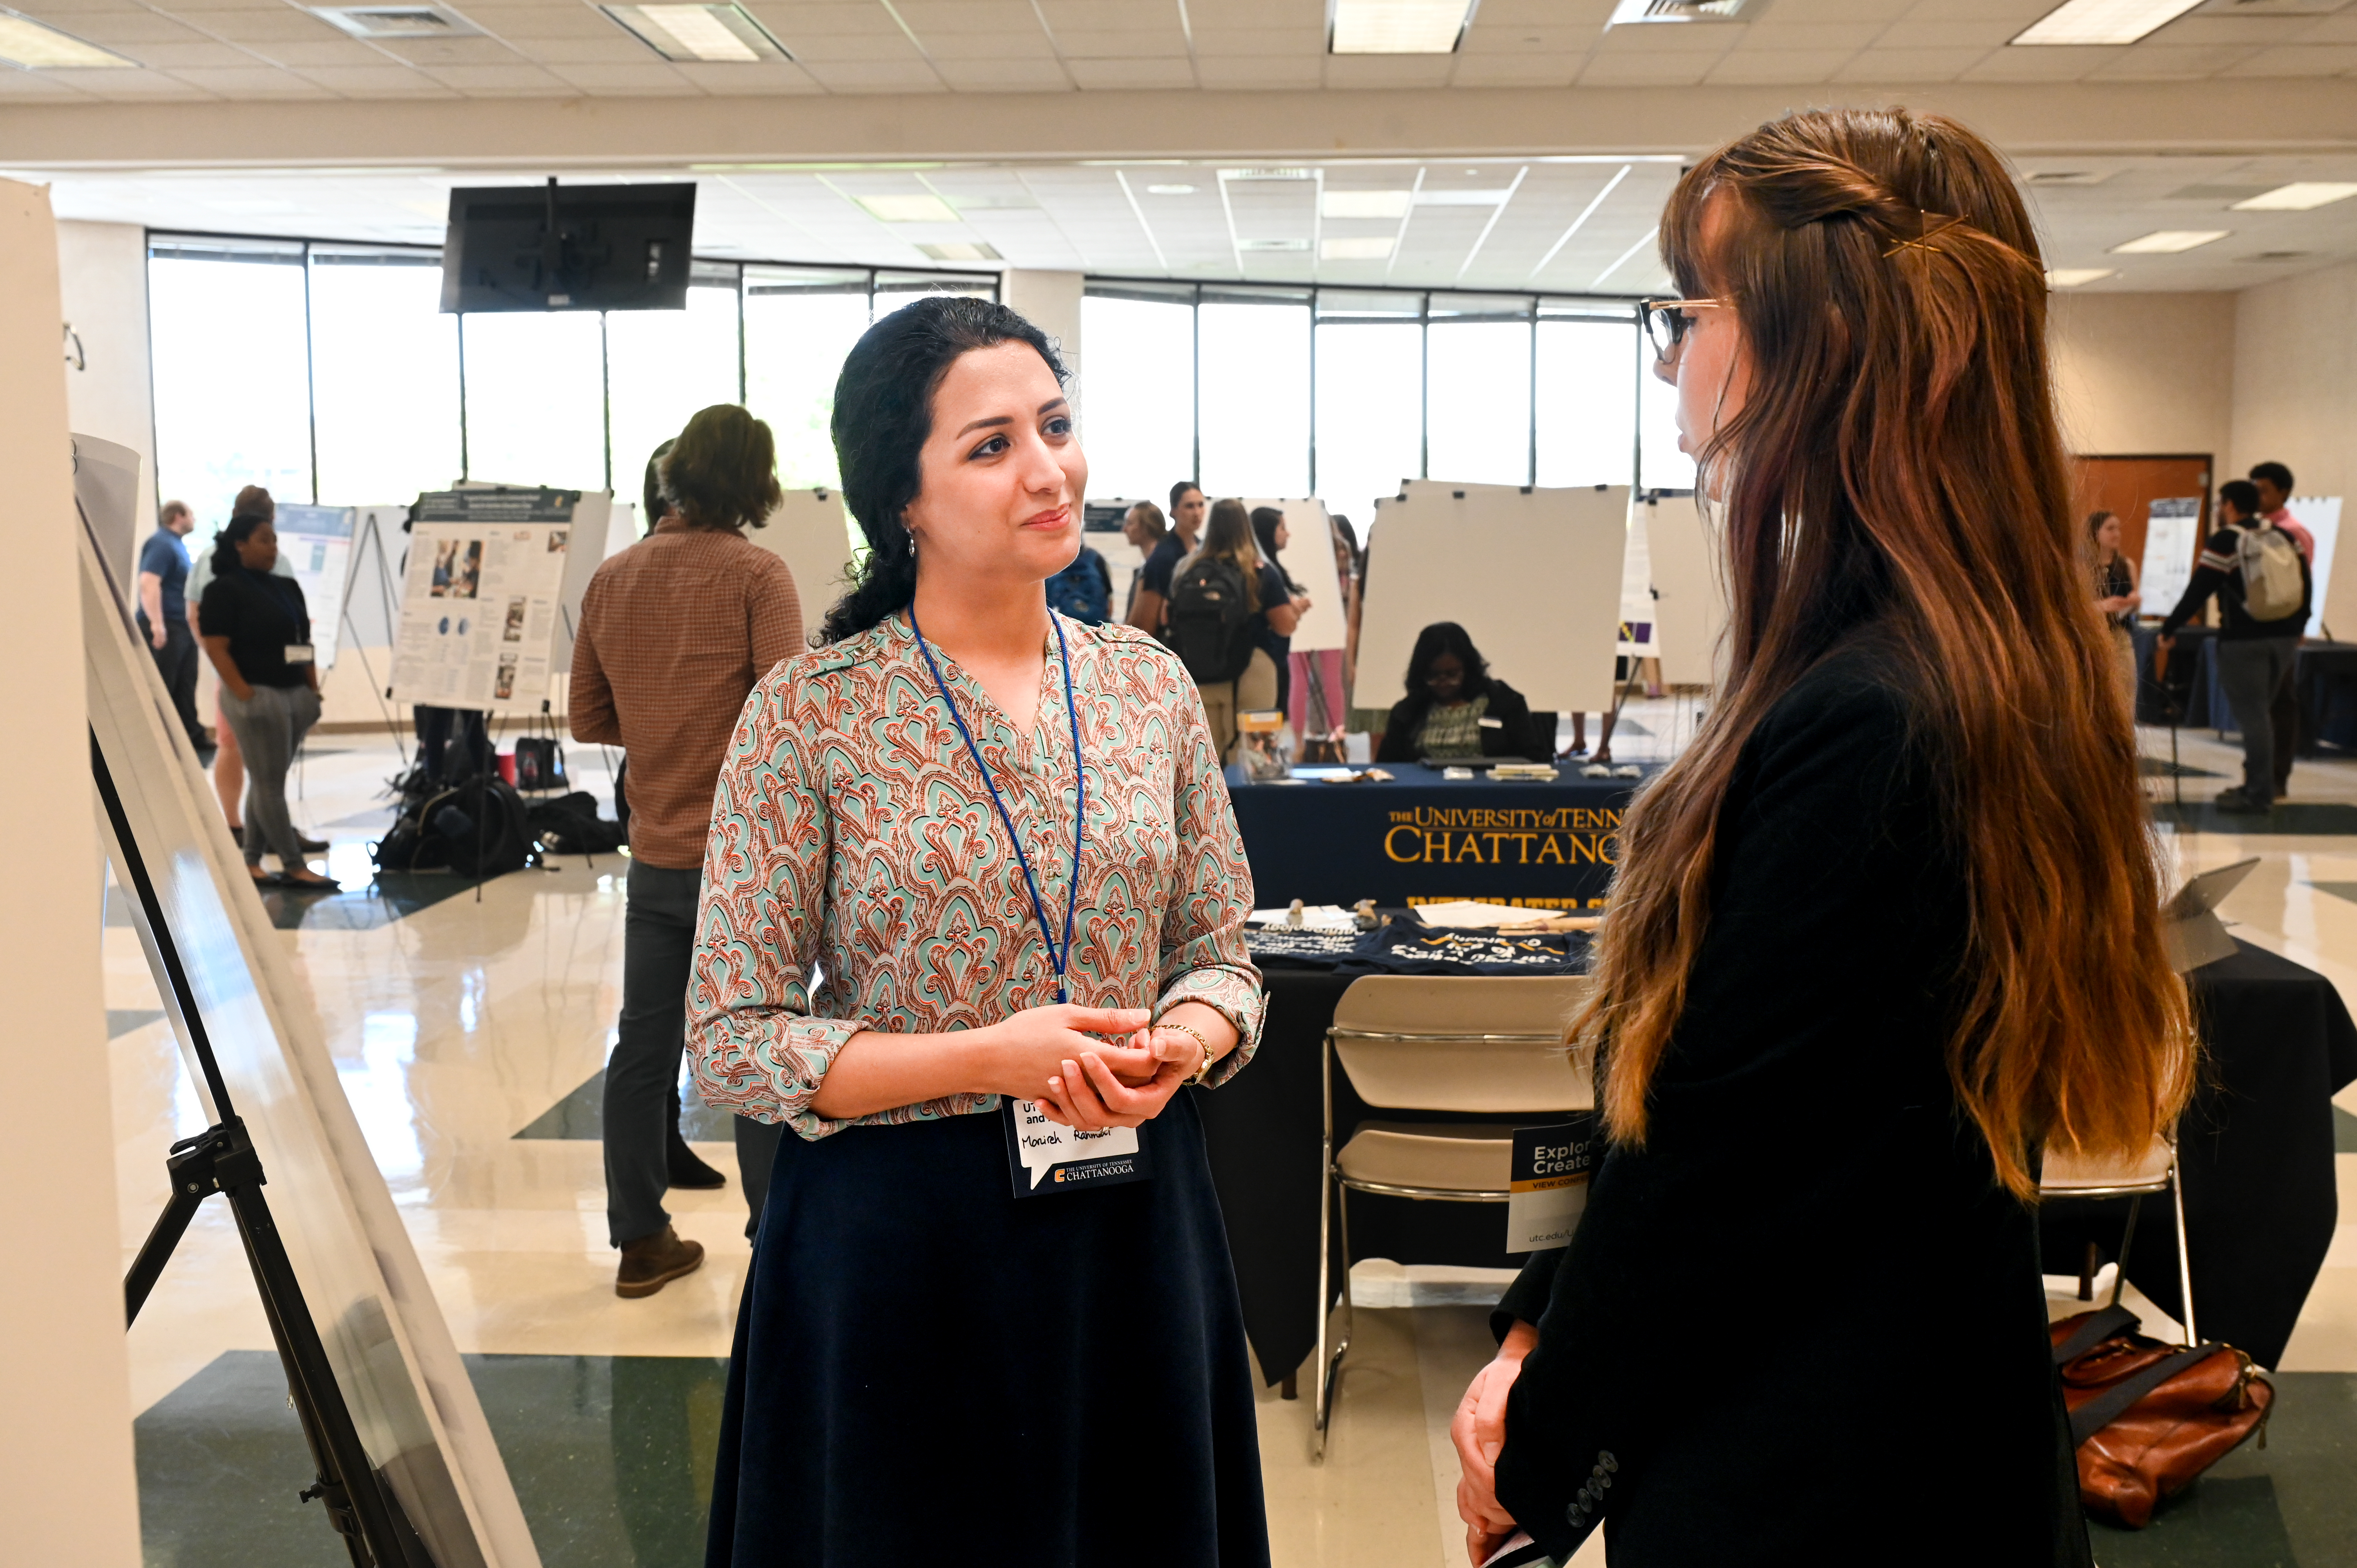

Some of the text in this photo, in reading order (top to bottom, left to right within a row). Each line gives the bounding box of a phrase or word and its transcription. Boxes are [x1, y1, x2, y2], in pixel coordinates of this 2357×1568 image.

[1388, 811, 1413, 822] THE
[1415, 807, 1543, 827] UNIVERSITY
[1026, 1114, 1045, 1124] and
[1067, 1164, 1134, 1181] CHATTANOOGA
[1533, 1156, 1590, 1174] Create
[1533, 1180, 1556, 1188] VIEW
